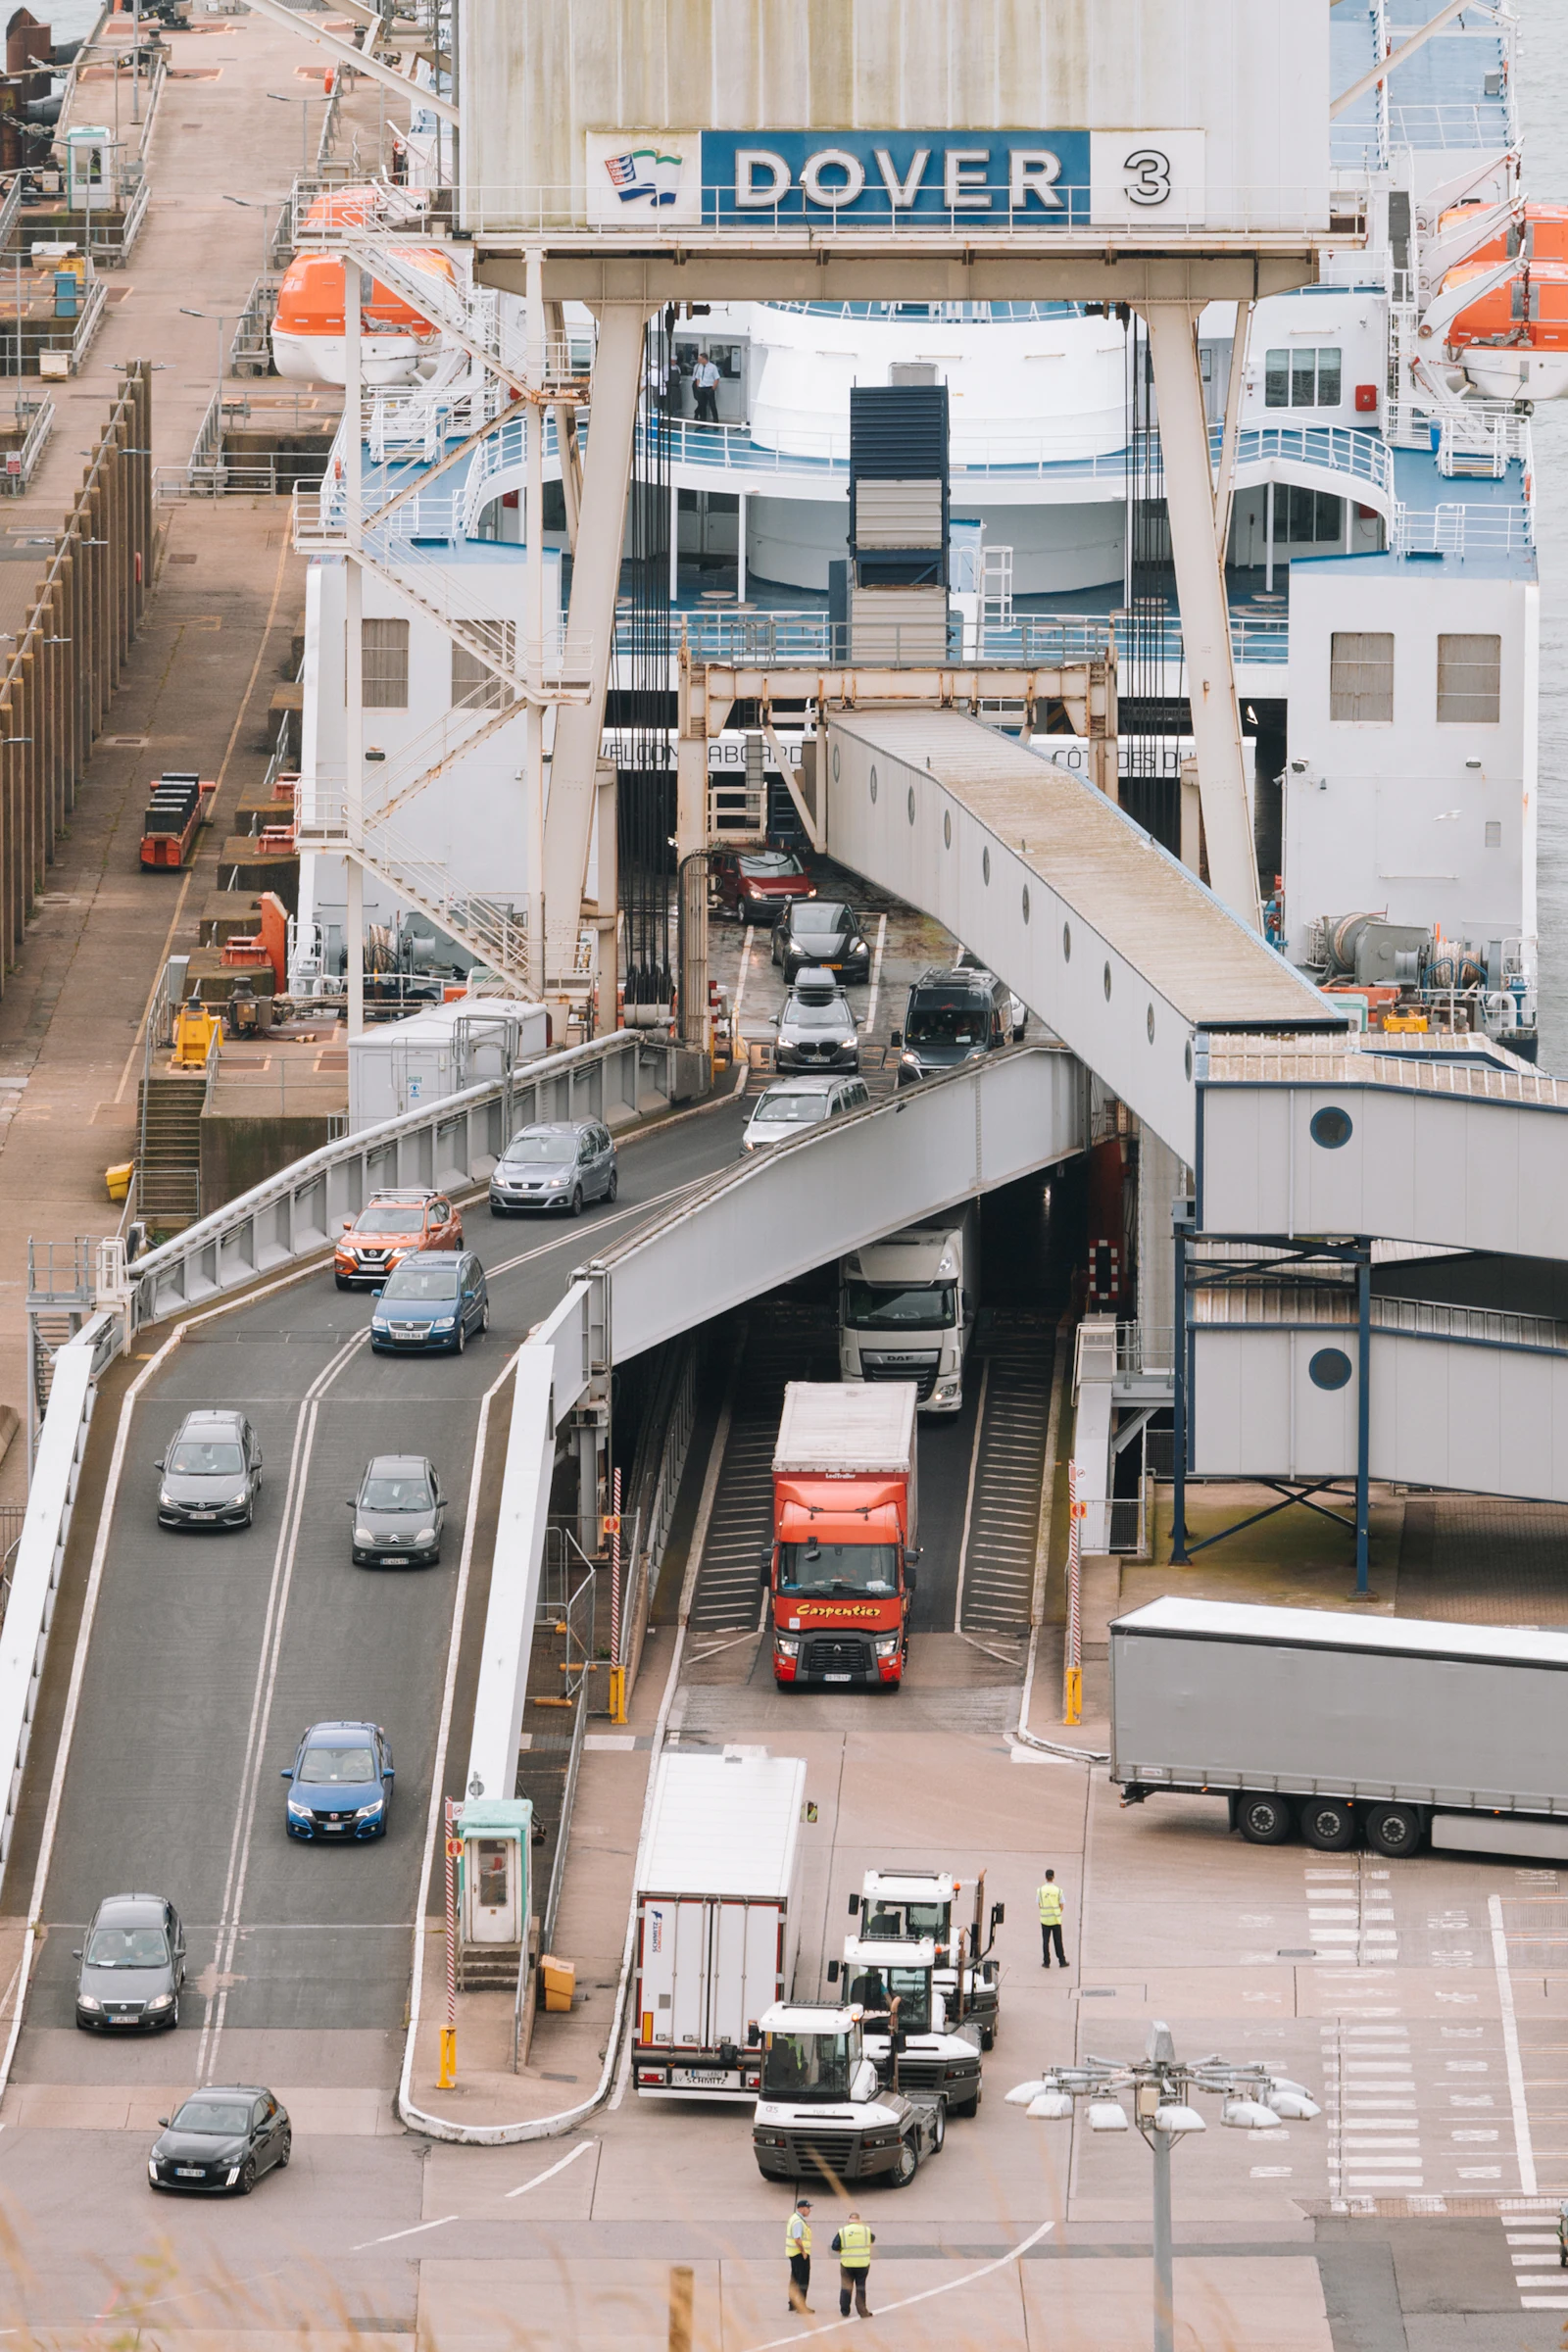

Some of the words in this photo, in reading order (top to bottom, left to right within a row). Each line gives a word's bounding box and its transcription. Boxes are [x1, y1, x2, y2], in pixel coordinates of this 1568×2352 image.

[736, 149, 1065, 208] DOVER
[1124, 149, 1171, 206] 3
[1117, 751, 1156, 769] DES
[797, 1603, 881, 1619] Carpentier
